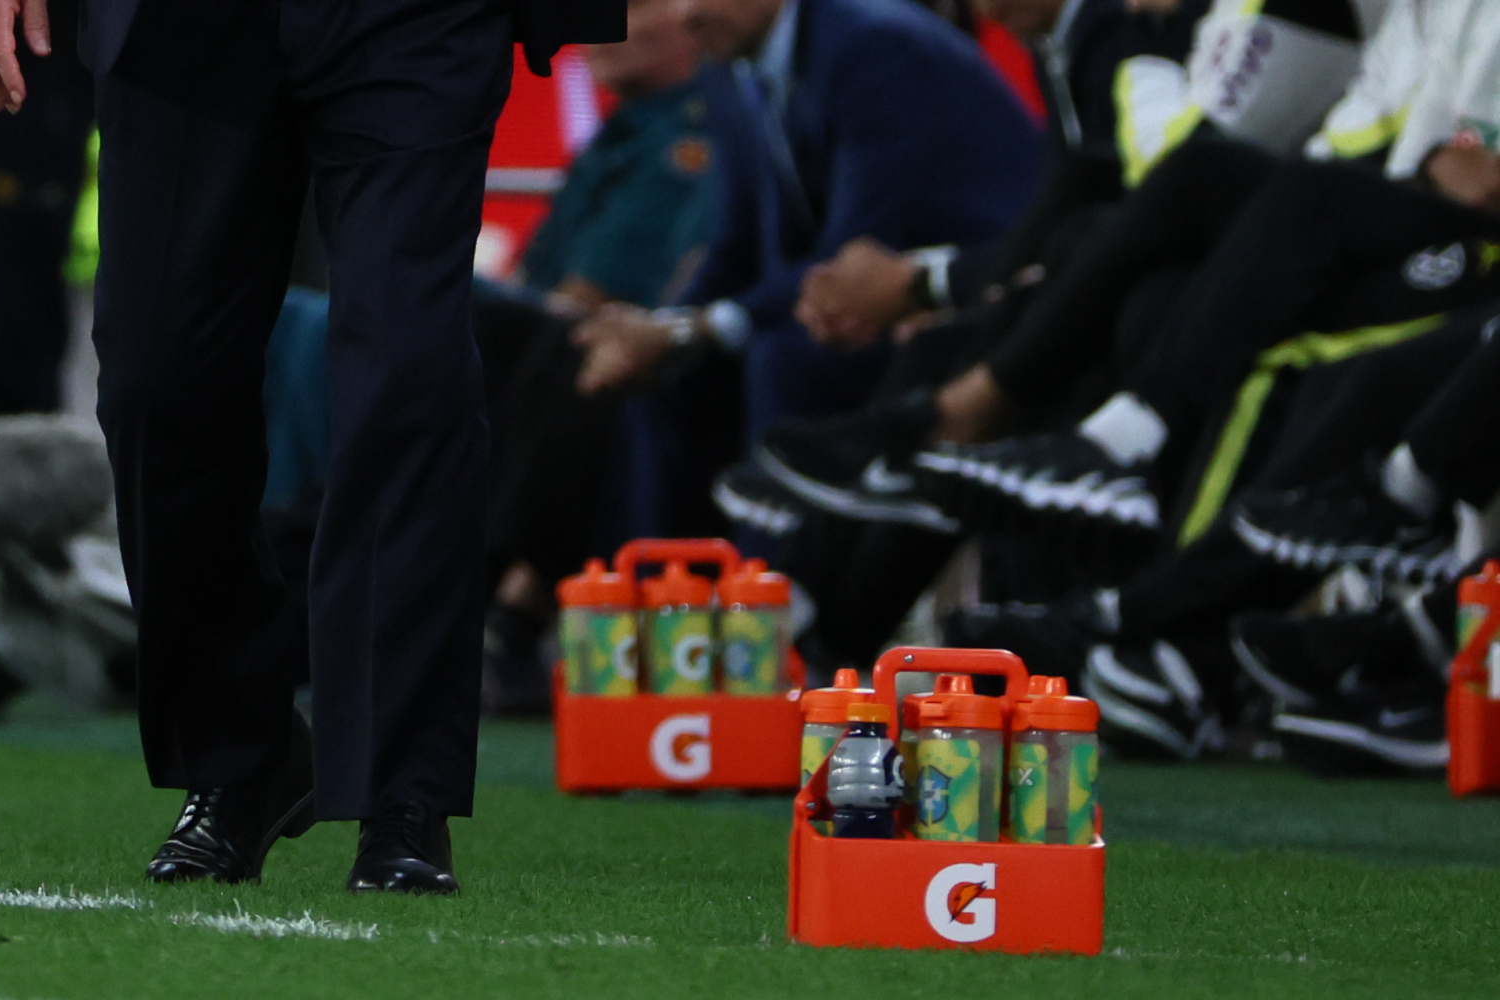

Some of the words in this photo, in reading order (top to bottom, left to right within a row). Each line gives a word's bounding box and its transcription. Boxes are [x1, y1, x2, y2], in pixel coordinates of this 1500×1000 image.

[672, 633, 711, 681] G
[650, 714, 712, 782] G
[924, 863, 997, 942] G
